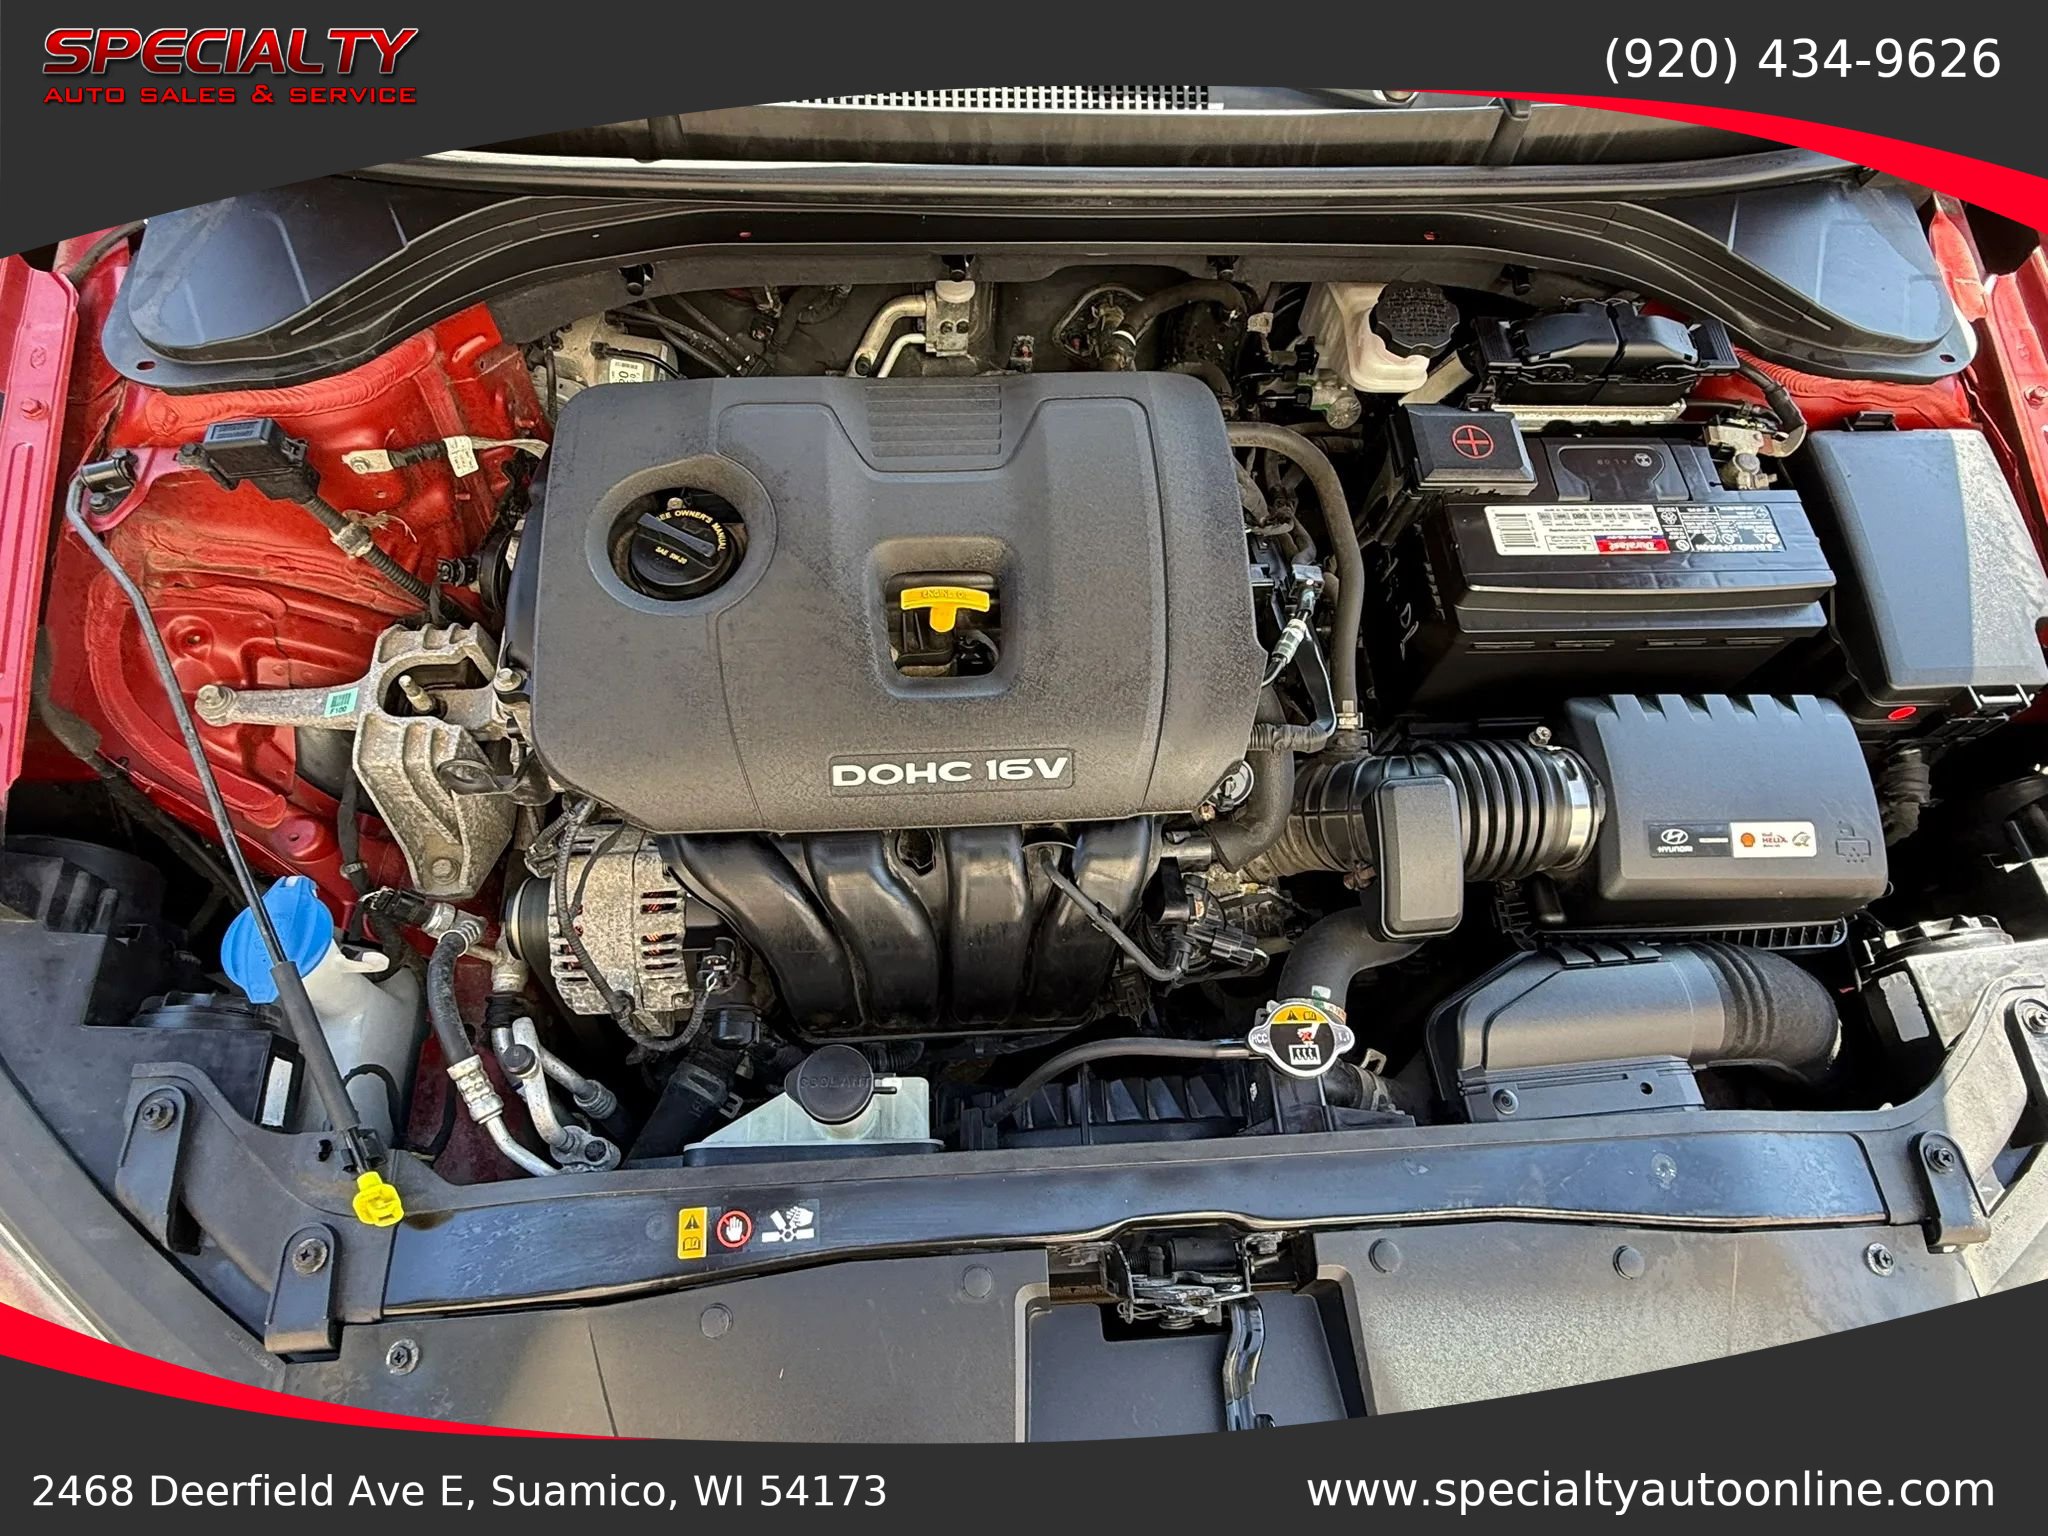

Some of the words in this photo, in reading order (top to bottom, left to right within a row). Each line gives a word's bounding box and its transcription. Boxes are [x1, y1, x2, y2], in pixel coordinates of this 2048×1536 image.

[674, 509, 713, 524] OWNER'S
[711, 522, 727, 551] MANUAL
[832, 761, 972, 786] DOHC
[986, 757, 1068, 781] 16V
